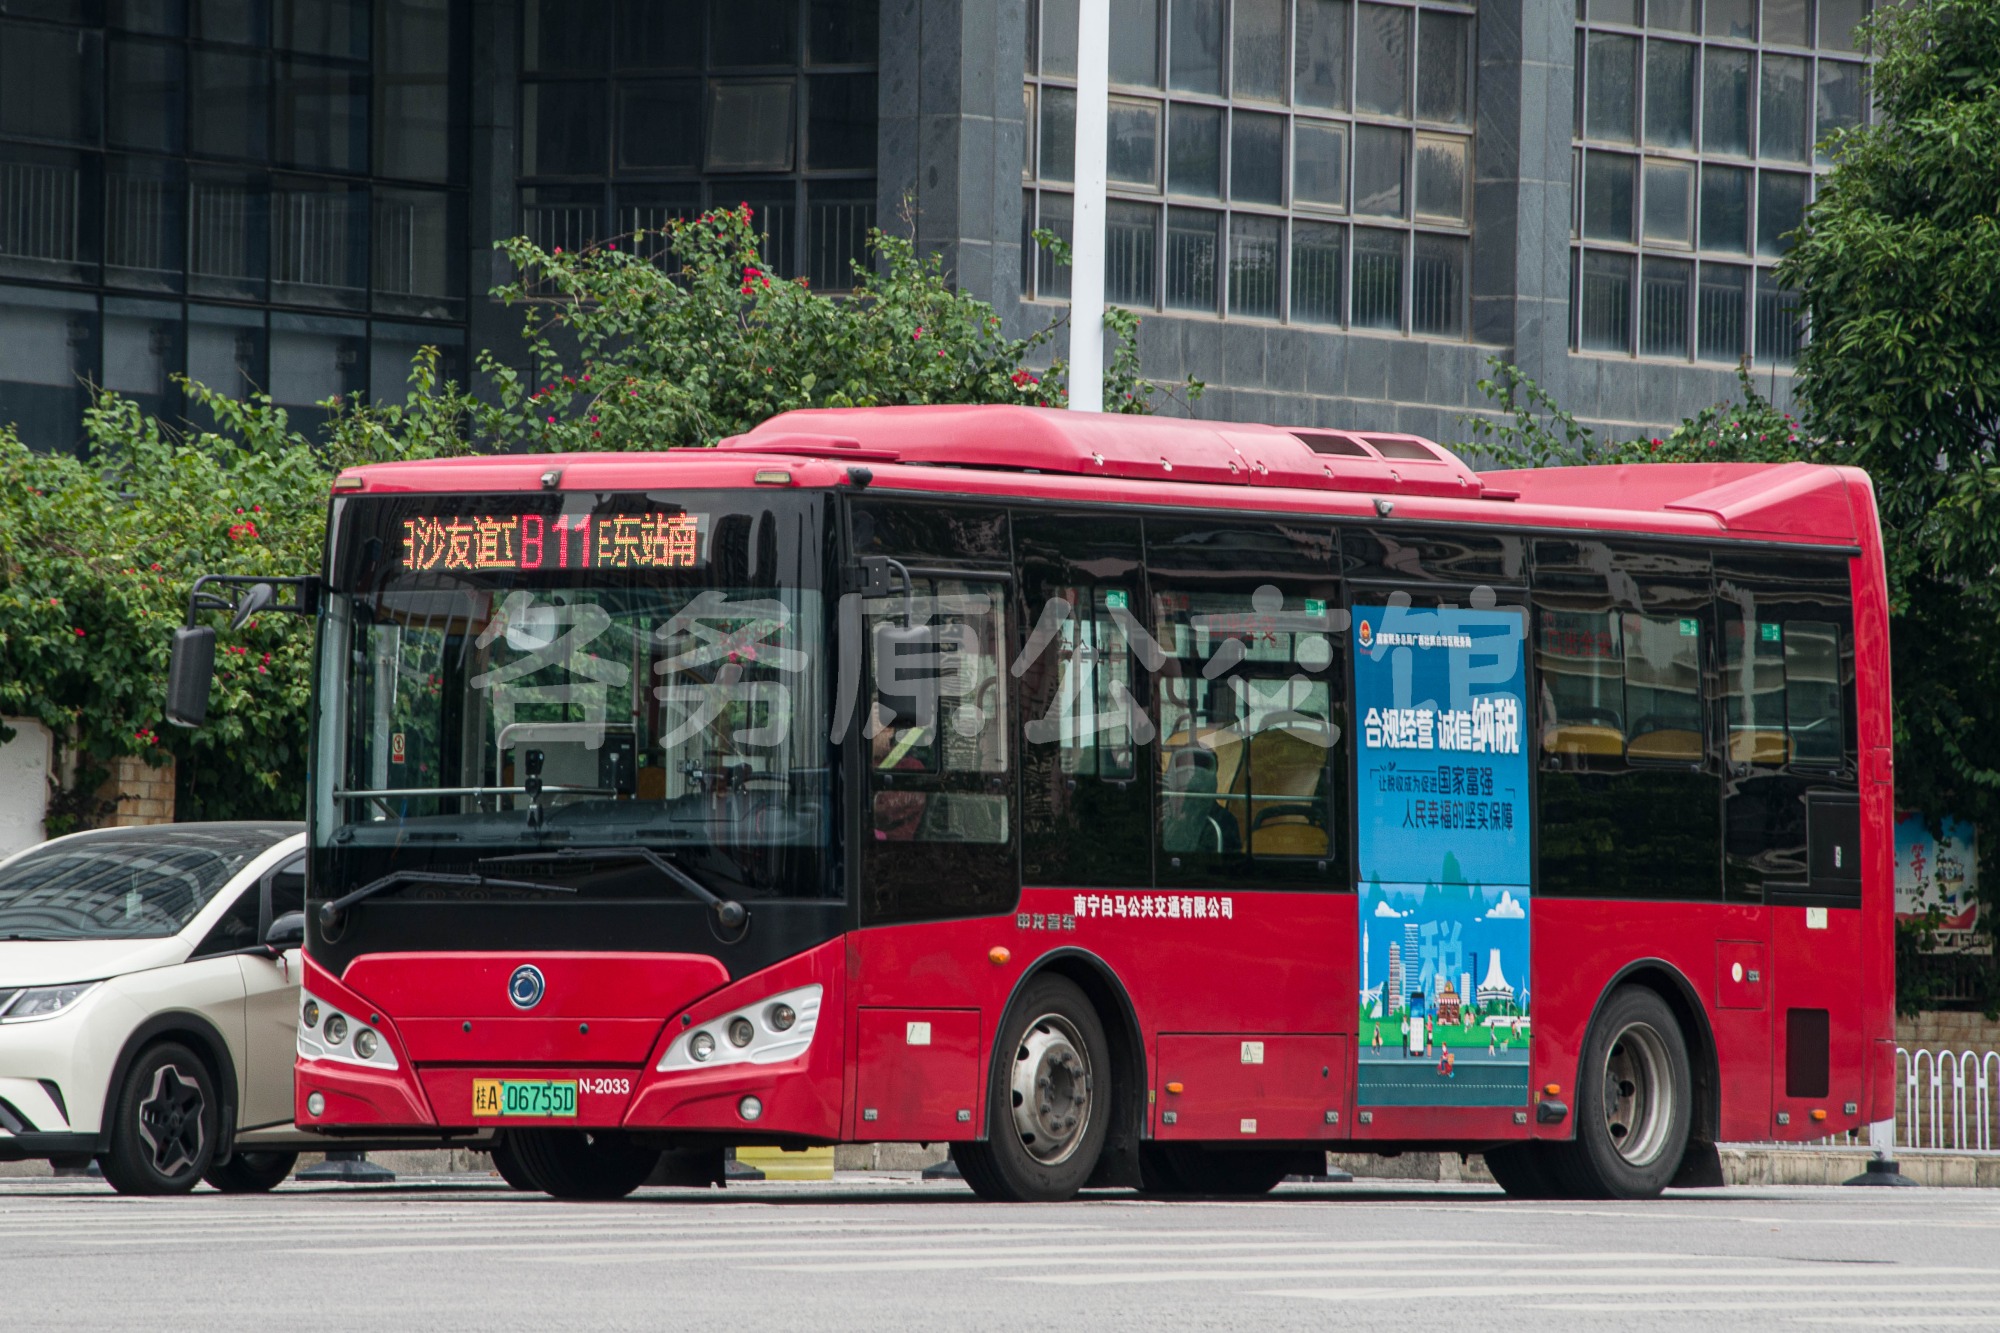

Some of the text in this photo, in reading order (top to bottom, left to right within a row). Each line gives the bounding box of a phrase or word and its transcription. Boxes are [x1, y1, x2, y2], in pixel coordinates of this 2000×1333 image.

[521, 514, 591, 568] B11
[1364, 697, 1519, 754] 合规经营 诚信纳税
[1402, 800, 1513, 831] 人民幸福的坚实保障
[1073, 894, 1233, 919] 南宁白马公共交通有限公司
[579, 1078, 630, 1095] N-2033
